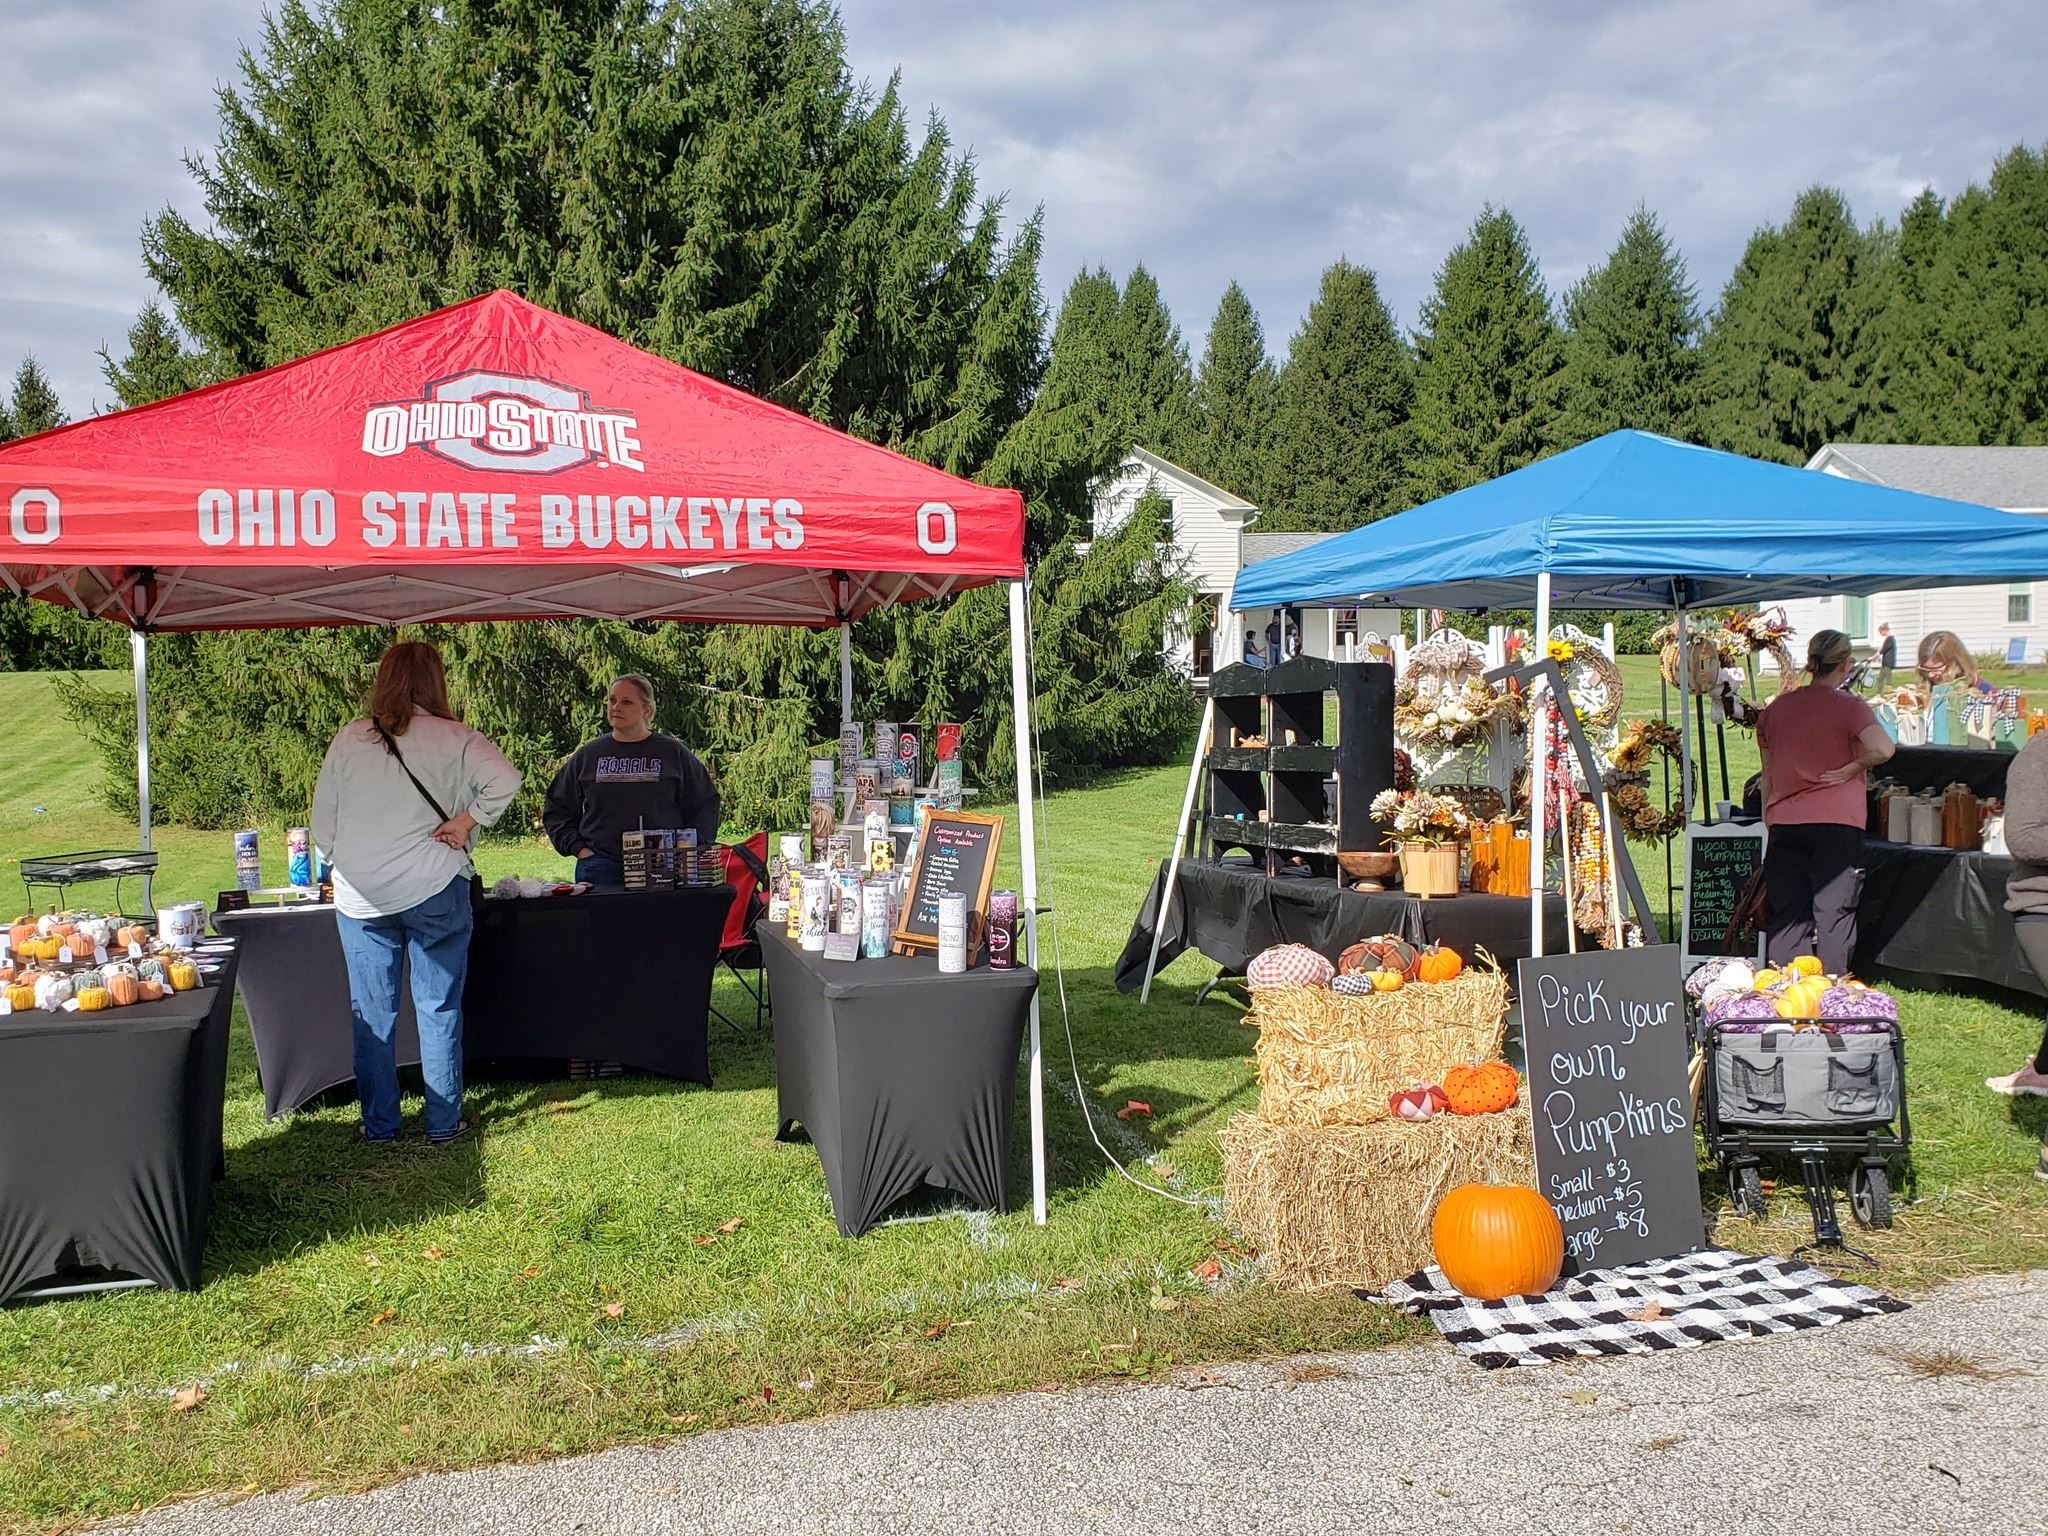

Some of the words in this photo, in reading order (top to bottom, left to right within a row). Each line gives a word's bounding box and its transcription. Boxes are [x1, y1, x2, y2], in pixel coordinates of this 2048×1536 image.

[362, 401, 486, 457] OHIO
[488, 399, 645, 472] STATE
[198, 488, 336, 547] OHIO
[362, 491, 518, 548] STATE
[542, 494, 805, 550] BUCKEYES
[597, 757, 661, 775] ROYALS
[1697, 841, 1727, 852] WOOD
[1733, 839, 1761, 850] BLOCK
[1693, 911, 1715, 927] Fall
[1537, 974, 1612, 1028] Pick
[1620, 1001, 1675, 1044] your
[1550, 1043, 1626, 1085] own
[1543, 1090, 1687, 1157] Pumpkins
[1551, 1166, 1595, 1200] Small
[1606, 1159, 1631, 1182] $3
[1614, 1181, 1642, 1207] $5
[1563, 1227, 1603, 1261] arge
[1615, 1208, 1649, 1237] $8
